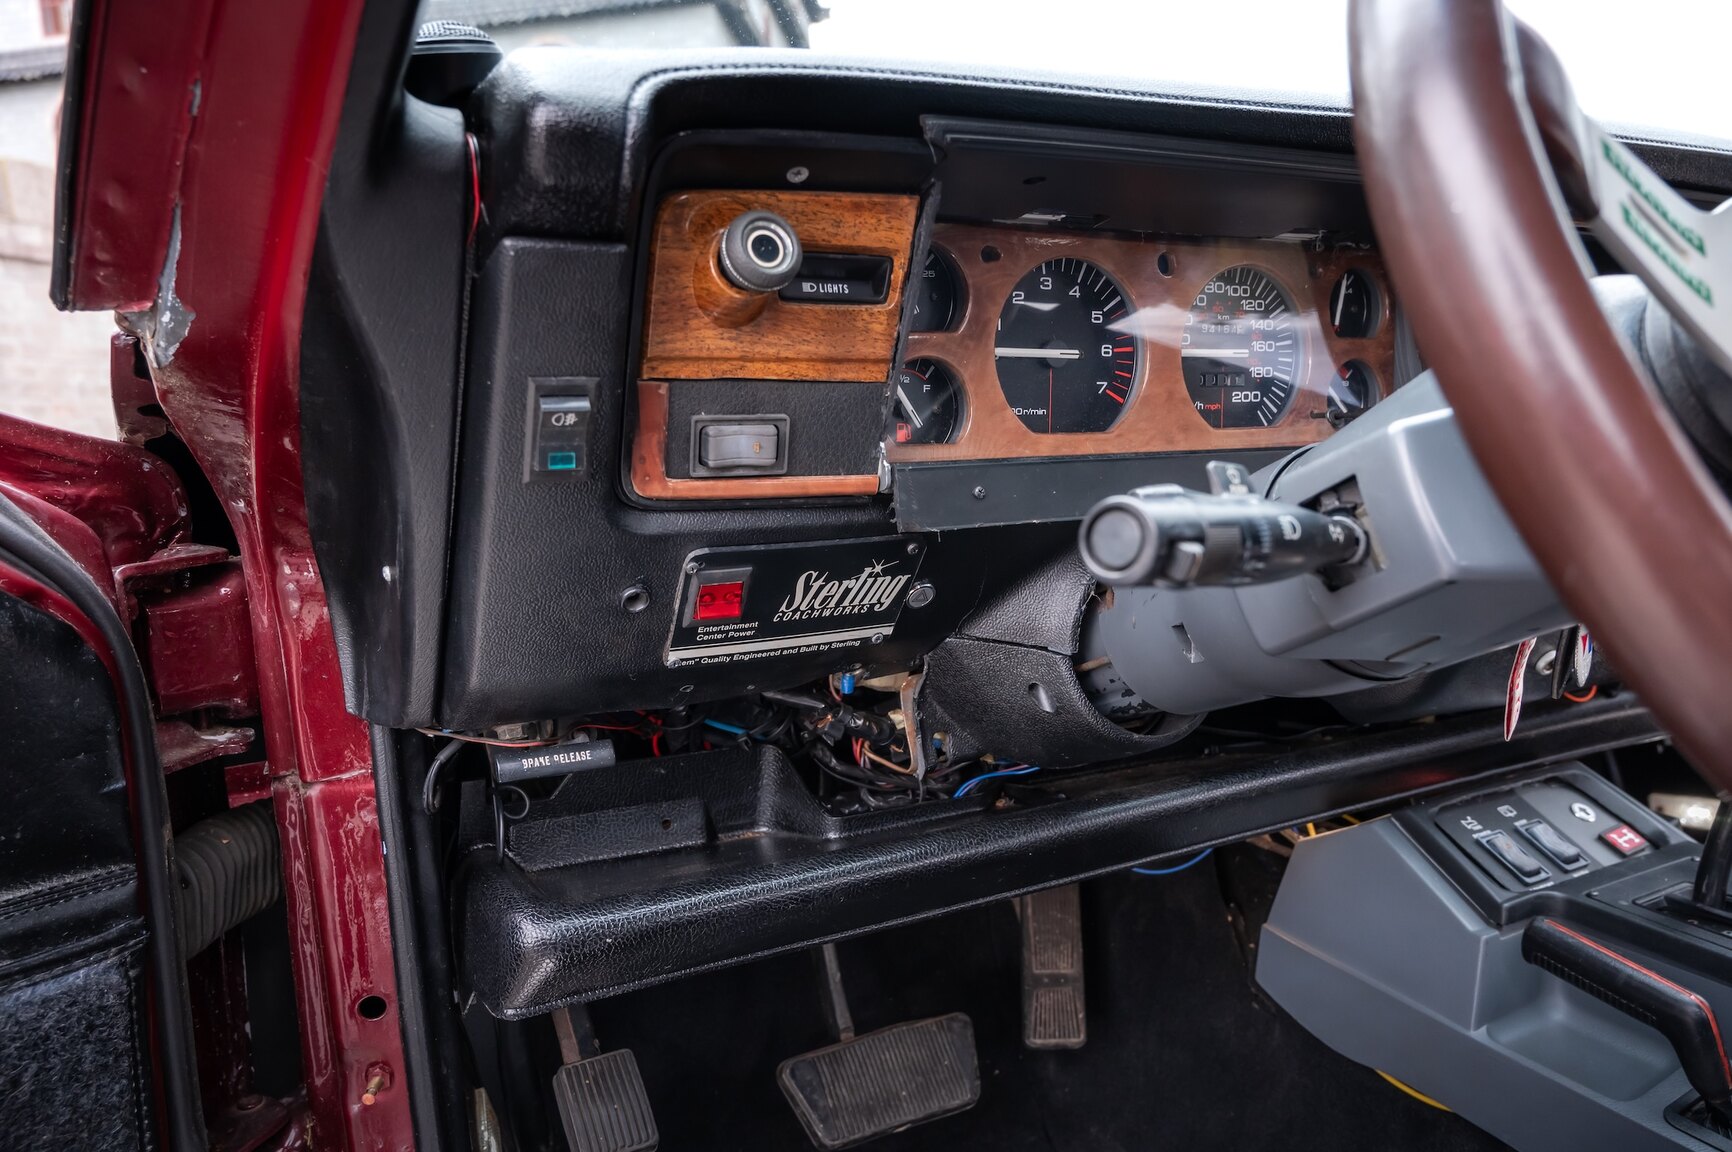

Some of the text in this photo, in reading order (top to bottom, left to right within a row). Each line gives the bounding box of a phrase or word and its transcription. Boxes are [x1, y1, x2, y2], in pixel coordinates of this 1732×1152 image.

[819, 283, 849, 294] LIGHTS
[1040, 277, 1052, 290] 3
[1068, 286, 1081, 298] 4
[1225, 285, 1250, 297] 100
[1012, 291, 1024, 304] 2
[1240, 300, 1265, 311] 120
[1091, 310, 1103, 323] 5
[1250, 320, 1274, 331] 140
[1101, 344, 1113, 357] 6
[1251, 340, 1275, 351] 160
[1249, 366, 1273, 378] 180
[923, 384, 931, 393] F
[1096, 381, 1108, 394] 7
[1231, 391, 1261, 403] 200
[779, 566, 911, 611] Sterling
[773, 605, 869, 622] COACHWORKS
[697, 621, 759, 633] Entertainment
[696, 630, 755, 641] Center Power
[701, 655, 731, 664] Quality
[733, 649, 781, 661] Engineered
[800, 645, 818, 653] Built
[831, 640, 861, 649] Sterling
[553, 750, 592, 765] RELEASE
